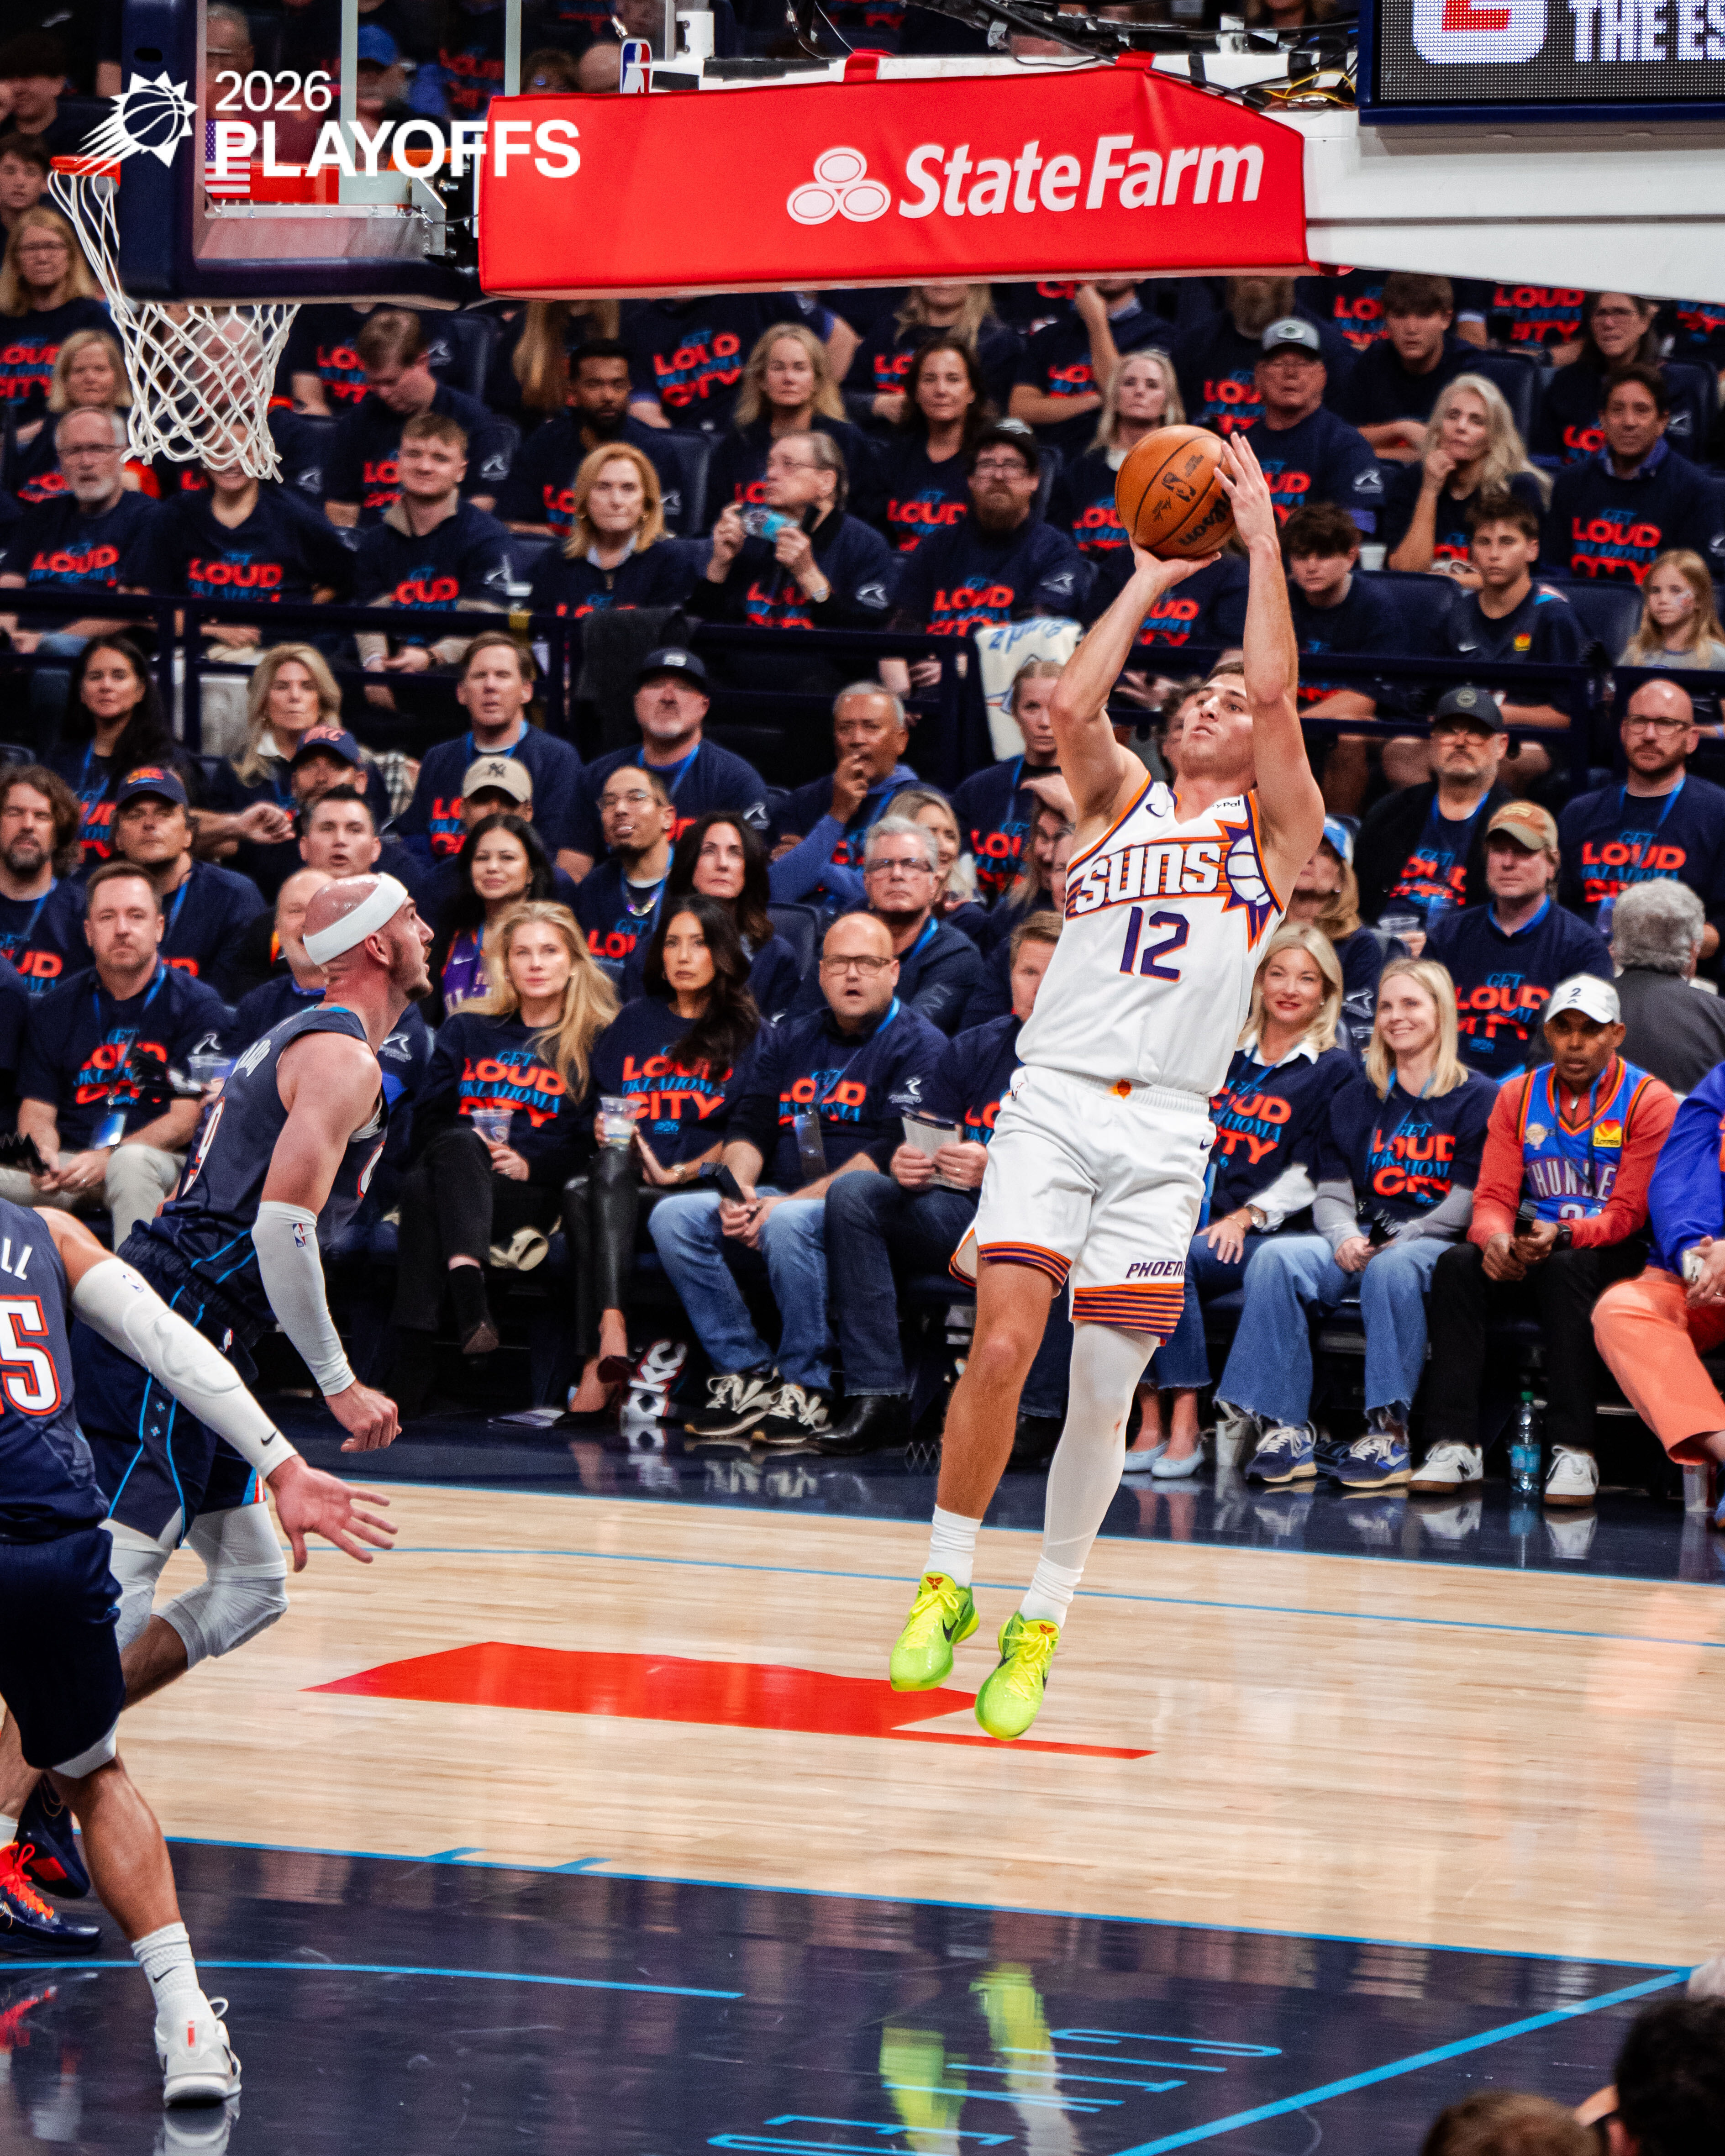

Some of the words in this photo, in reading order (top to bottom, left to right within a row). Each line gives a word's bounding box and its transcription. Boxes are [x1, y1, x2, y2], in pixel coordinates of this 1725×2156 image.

[1569, 0, 1667, 61] THE
[1572, 517, 1662, 547] LOUD
[188, 557, 284, 588] LOUD
[1150, 599, 1199, 620] UD
[1582, 842, 1686, 869] LOUD
[1077, 844, 1221, 914] SUNS
[1120, 907, 1191, 983] 12
[1486, 973, 1525, 989] GET
[496, 1050, 536, 1067] GET
[463, 1057, 566, 1096] LOUD
